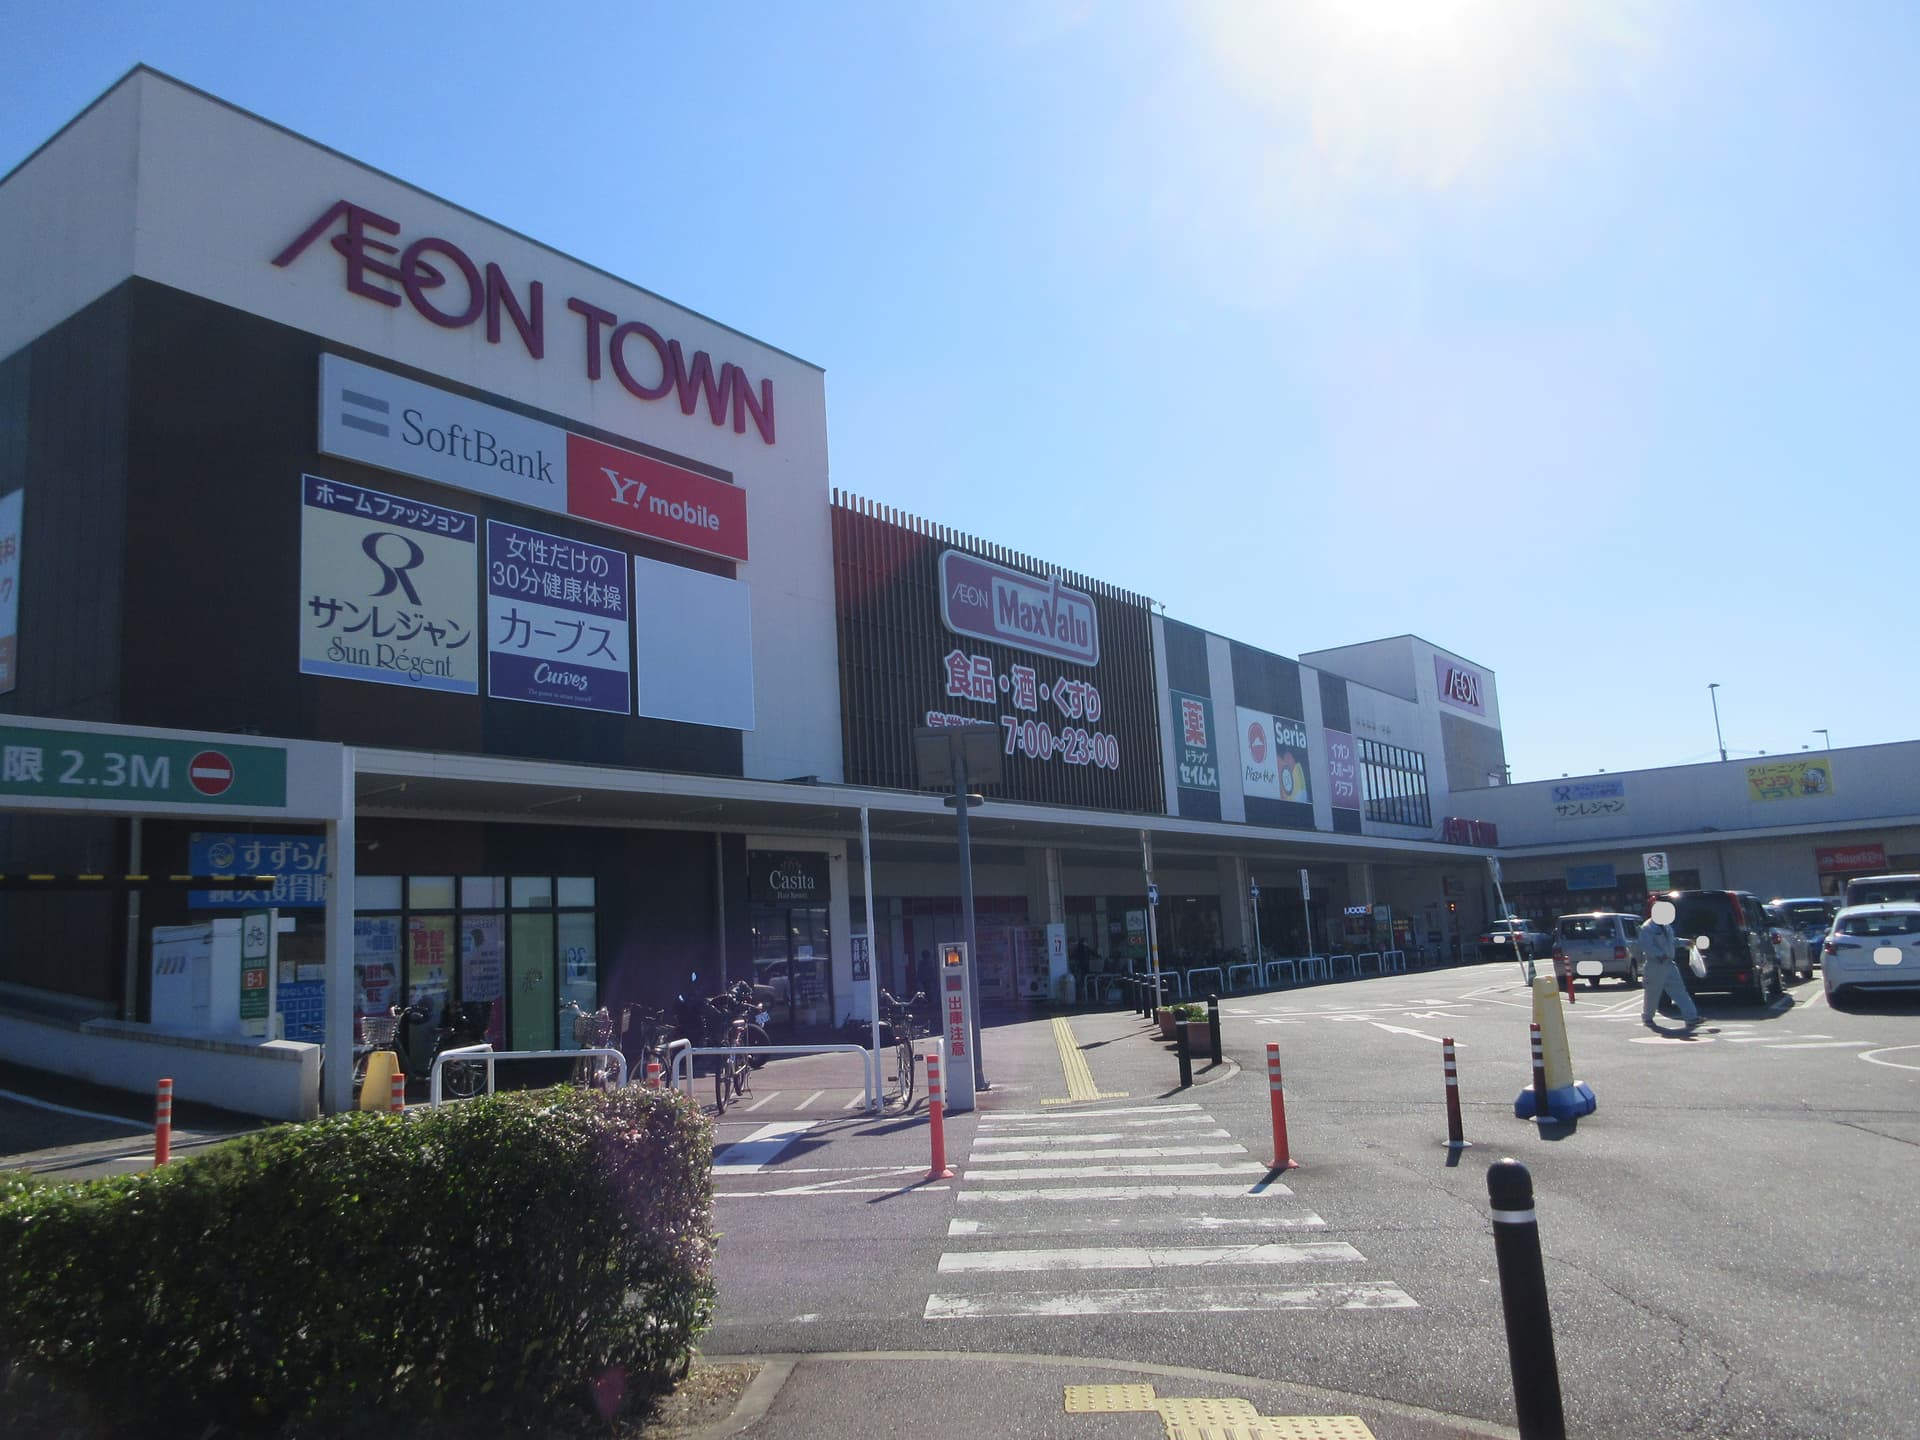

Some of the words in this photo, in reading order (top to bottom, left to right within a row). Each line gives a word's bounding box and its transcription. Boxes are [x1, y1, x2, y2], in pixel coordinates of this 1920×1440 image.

[567, 296, 776, 445] TOWN
[402, 408, 553, 484] SoftBank
[315, 484, 466, 534] ホームファッション
[505, 533, 610, 578] 女性だけの
[492, 561, 623, 612] 30分健康体操
[308, 595, 471, 651] サンレジャン
[499, 608, 617, 661] カーブス
[998, 581, 1089, 648] MaxValu
[327, 636, 371, 666] Sun
[375, 644, 454, 682] Régent
[533, 662, 589, 691] Curves
[1182, 700, 1206, 746] 薬
[1275, 721, 1307, 750] Seria
[2, 746, 43, 782] 限
[58, 750, 170, 790] 2.3M
[1185, 749, 1209, 764] ドラッグ
[1330, 743, 1350, 759] イオン
[1179, 762, 1217, 787] セイムス
[1263, 768, 1276, 784] Hut
[1335, 781, 1353, 797] クラブ
[1555, 800, 1625, 816] サンレジャン
[769, 870, 815, 889] Casita
[247, 972, 263, 987] B-1
[948, 996, 965, 1056] 出庫注意
